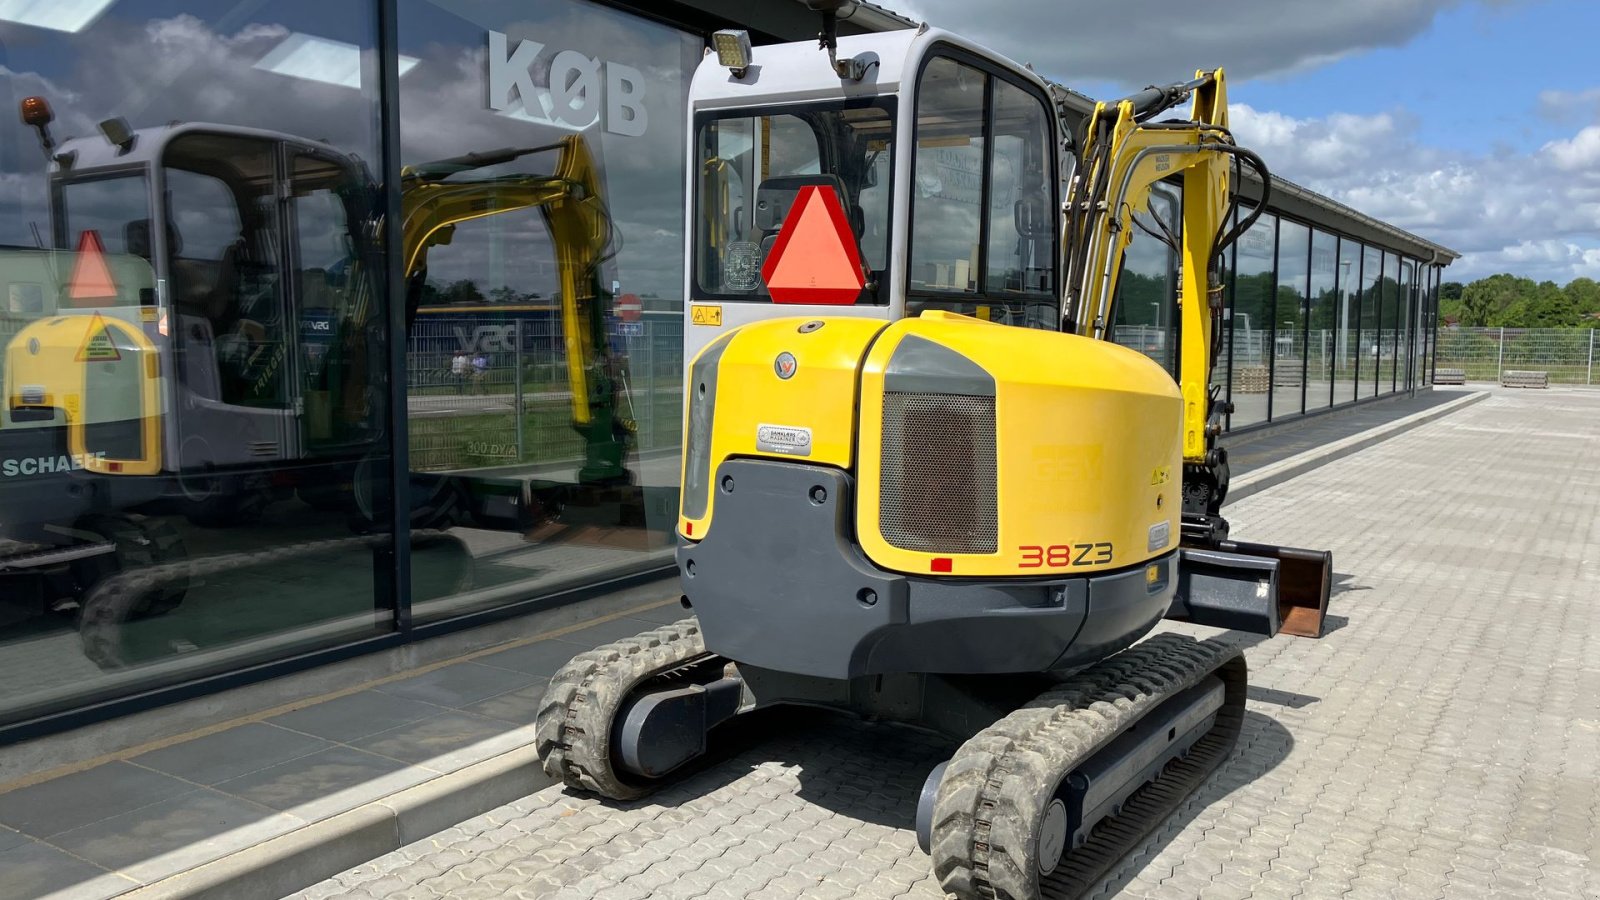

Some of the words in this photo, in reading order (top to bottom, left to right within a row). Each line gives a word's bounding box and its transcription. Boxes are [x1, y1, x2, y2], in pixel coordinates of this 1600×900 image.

[489, 30, 648, 137] KØB
[2, 451, 106, 477] SCHAEFF
[1018, 542, 1113, 568] 38Z3
